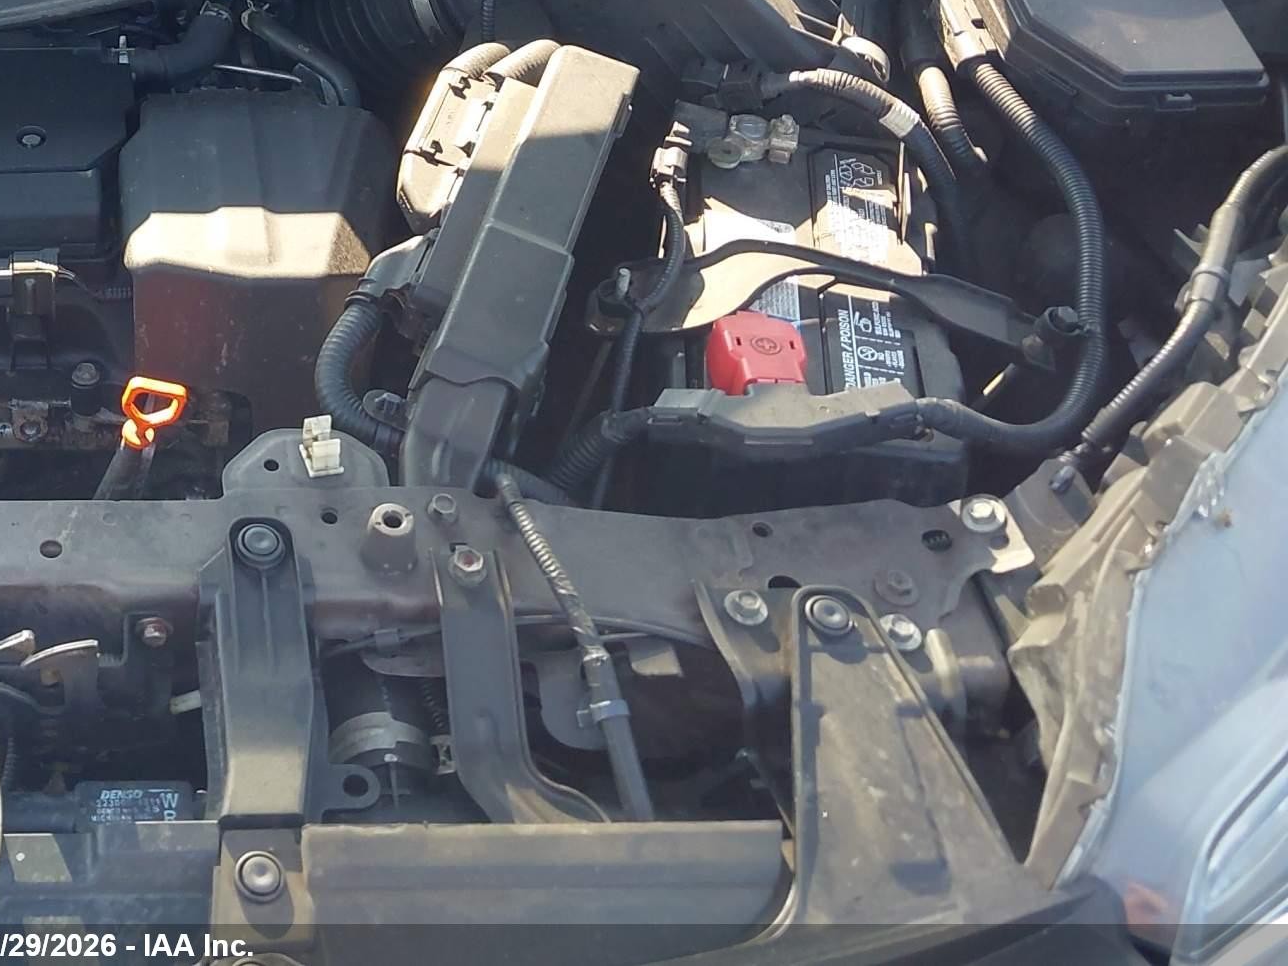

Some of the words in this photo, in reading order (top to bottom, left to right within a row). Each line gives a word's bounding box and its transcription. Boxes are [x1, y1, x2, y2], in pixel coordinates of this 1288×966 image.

[837, 308, 852, 343] POISON
[100, 789, 144, 800] DENSO
[159, 792, 179, 809] W
